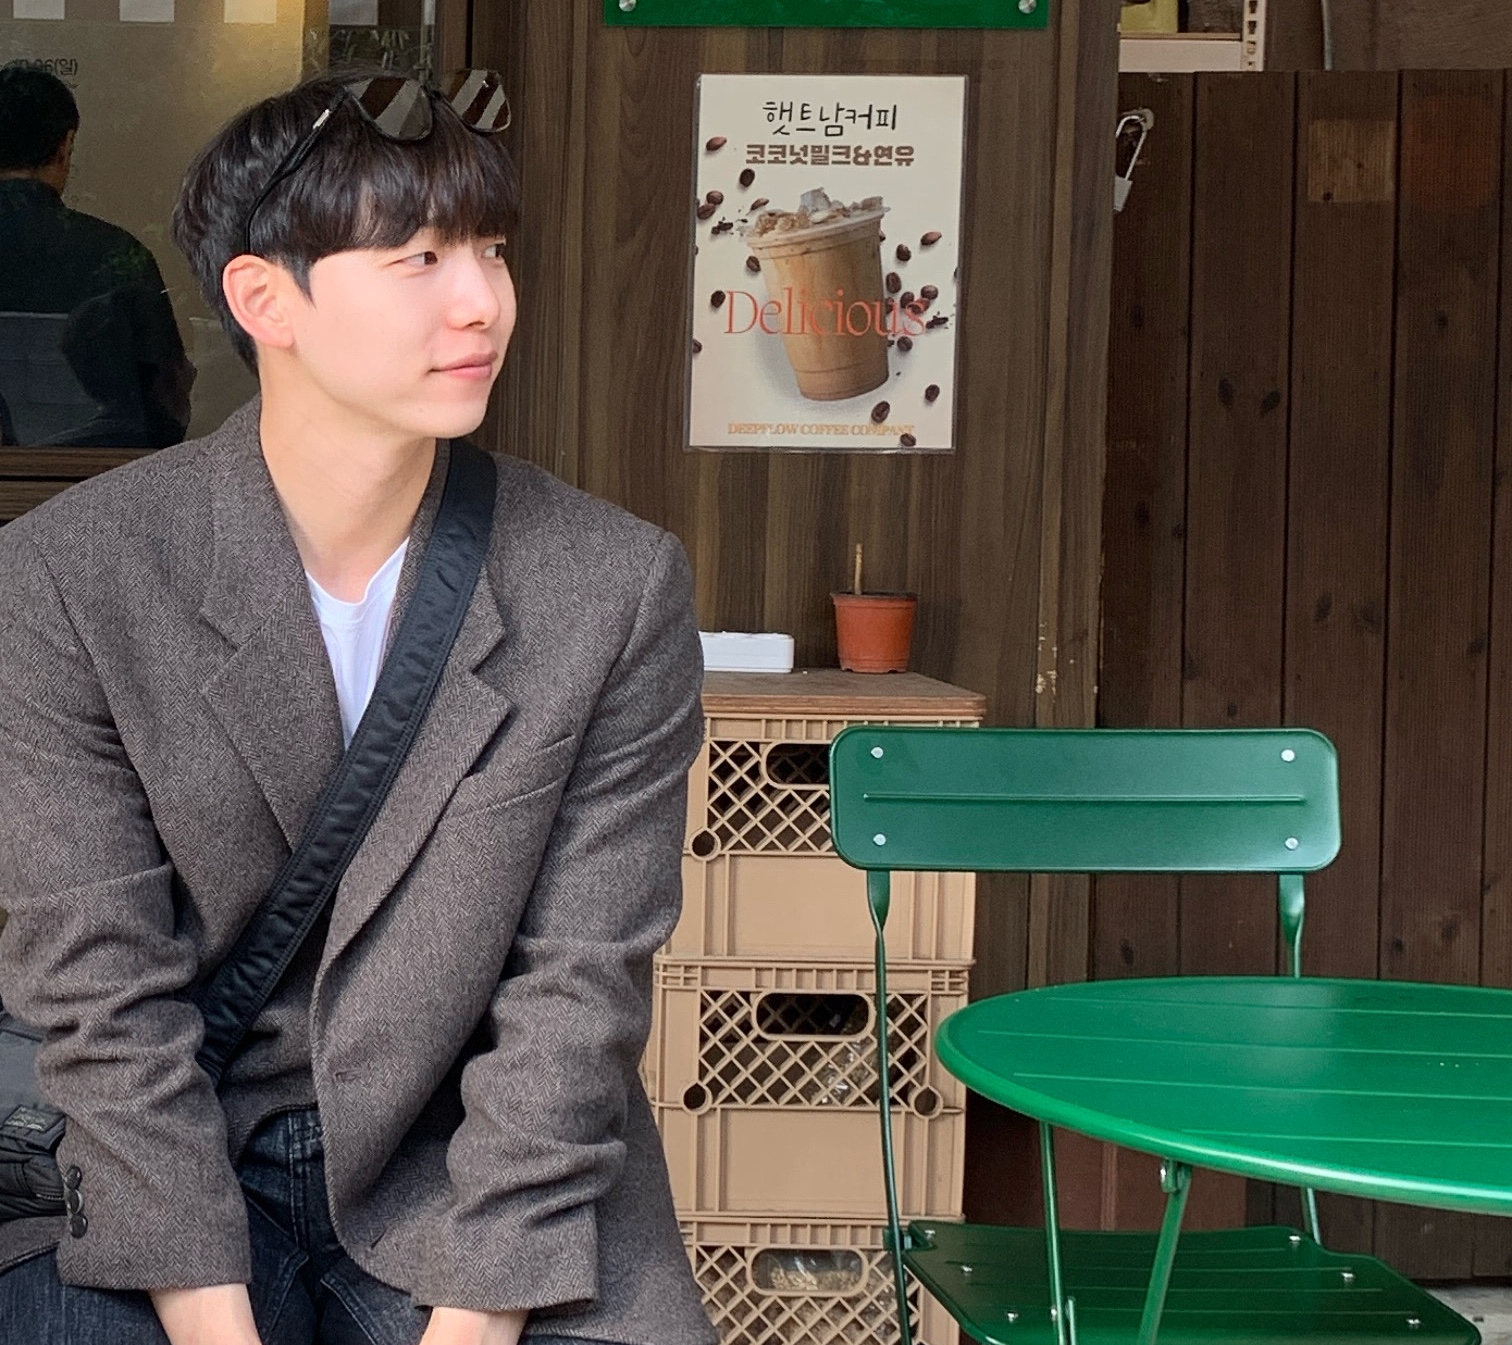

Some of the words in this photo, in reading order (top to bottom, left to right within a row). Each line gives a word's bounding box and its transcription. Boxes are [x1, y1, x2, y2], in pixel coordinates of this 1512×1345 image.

[724, 288, 926, 336] Delicious
[728, 423, 797, 435] DEEPFLOW
[800, 423, 849, 435] COFFEE
[851, 423, 915, 436] COMPANY
